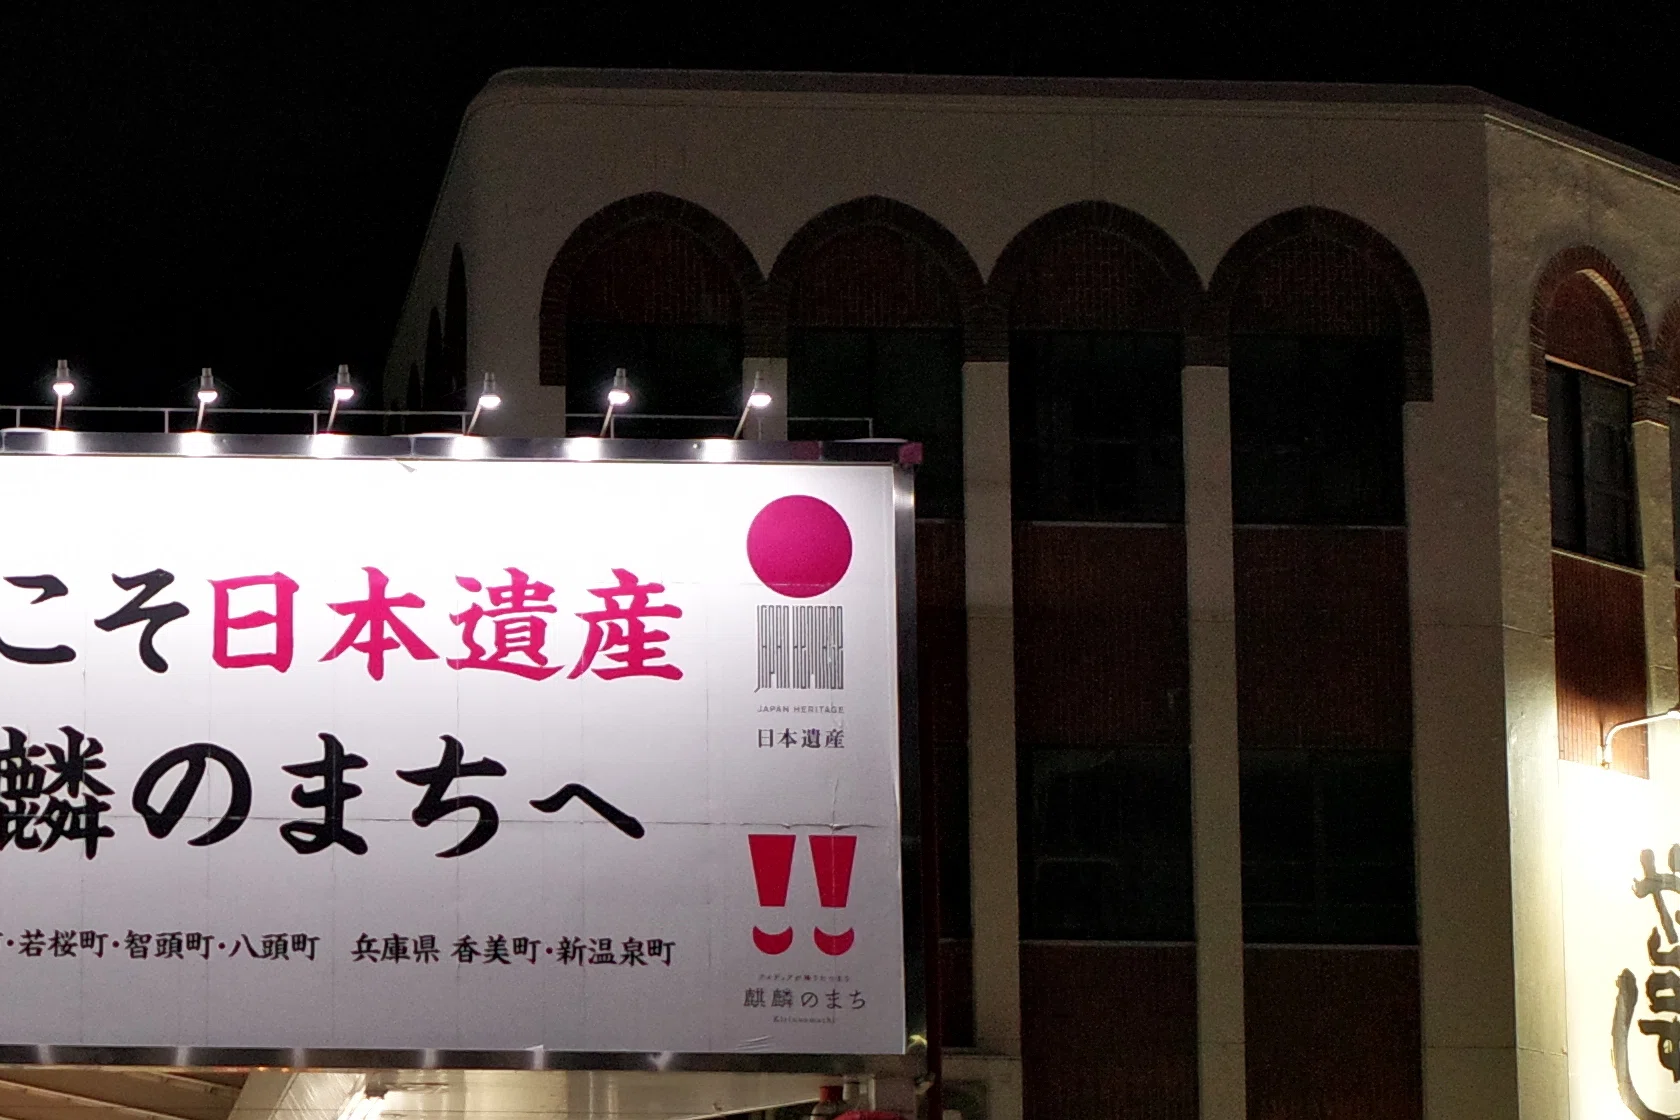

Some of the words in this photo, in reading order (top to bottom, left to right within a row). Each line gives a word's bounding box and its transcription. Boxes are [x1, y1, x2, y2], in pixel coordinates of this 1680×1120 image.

[757, 705, 790, 713] JAPAN
[794, 705, 845, 714] HERITAGE
[757, 728, 845, 749] 日本遺産
[351, 932, 440, 964] 兵庫県
[450, 933, 676, 968] 香美町・新温泉町
[743, 987, 866, 1010] 麒麟のまち
